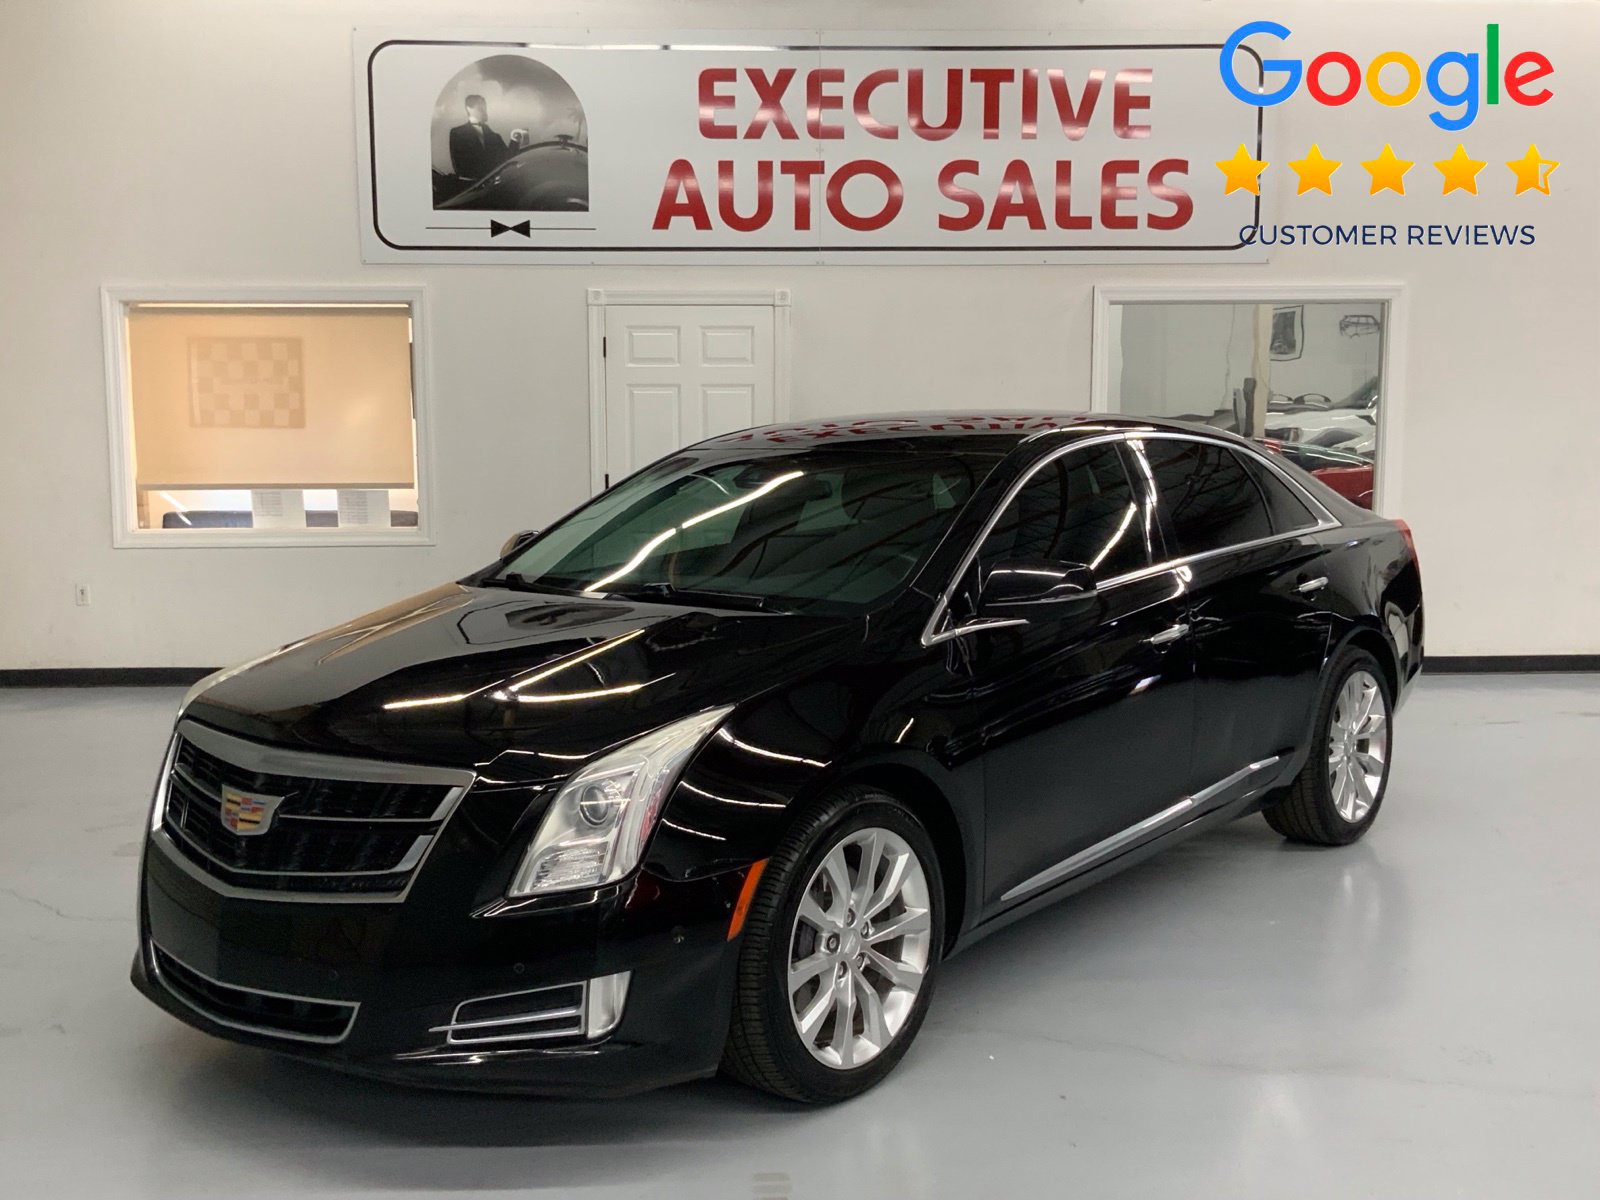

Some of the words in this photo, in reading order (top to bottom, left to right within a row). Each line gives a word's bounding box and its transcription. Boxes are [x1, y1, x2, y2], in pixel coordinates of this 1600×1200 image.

[698, 67, 1153, 141] EXECUTIVE
[652, 159, 904, 232] AUTO
[937, 157, 1194, 232] SALES
